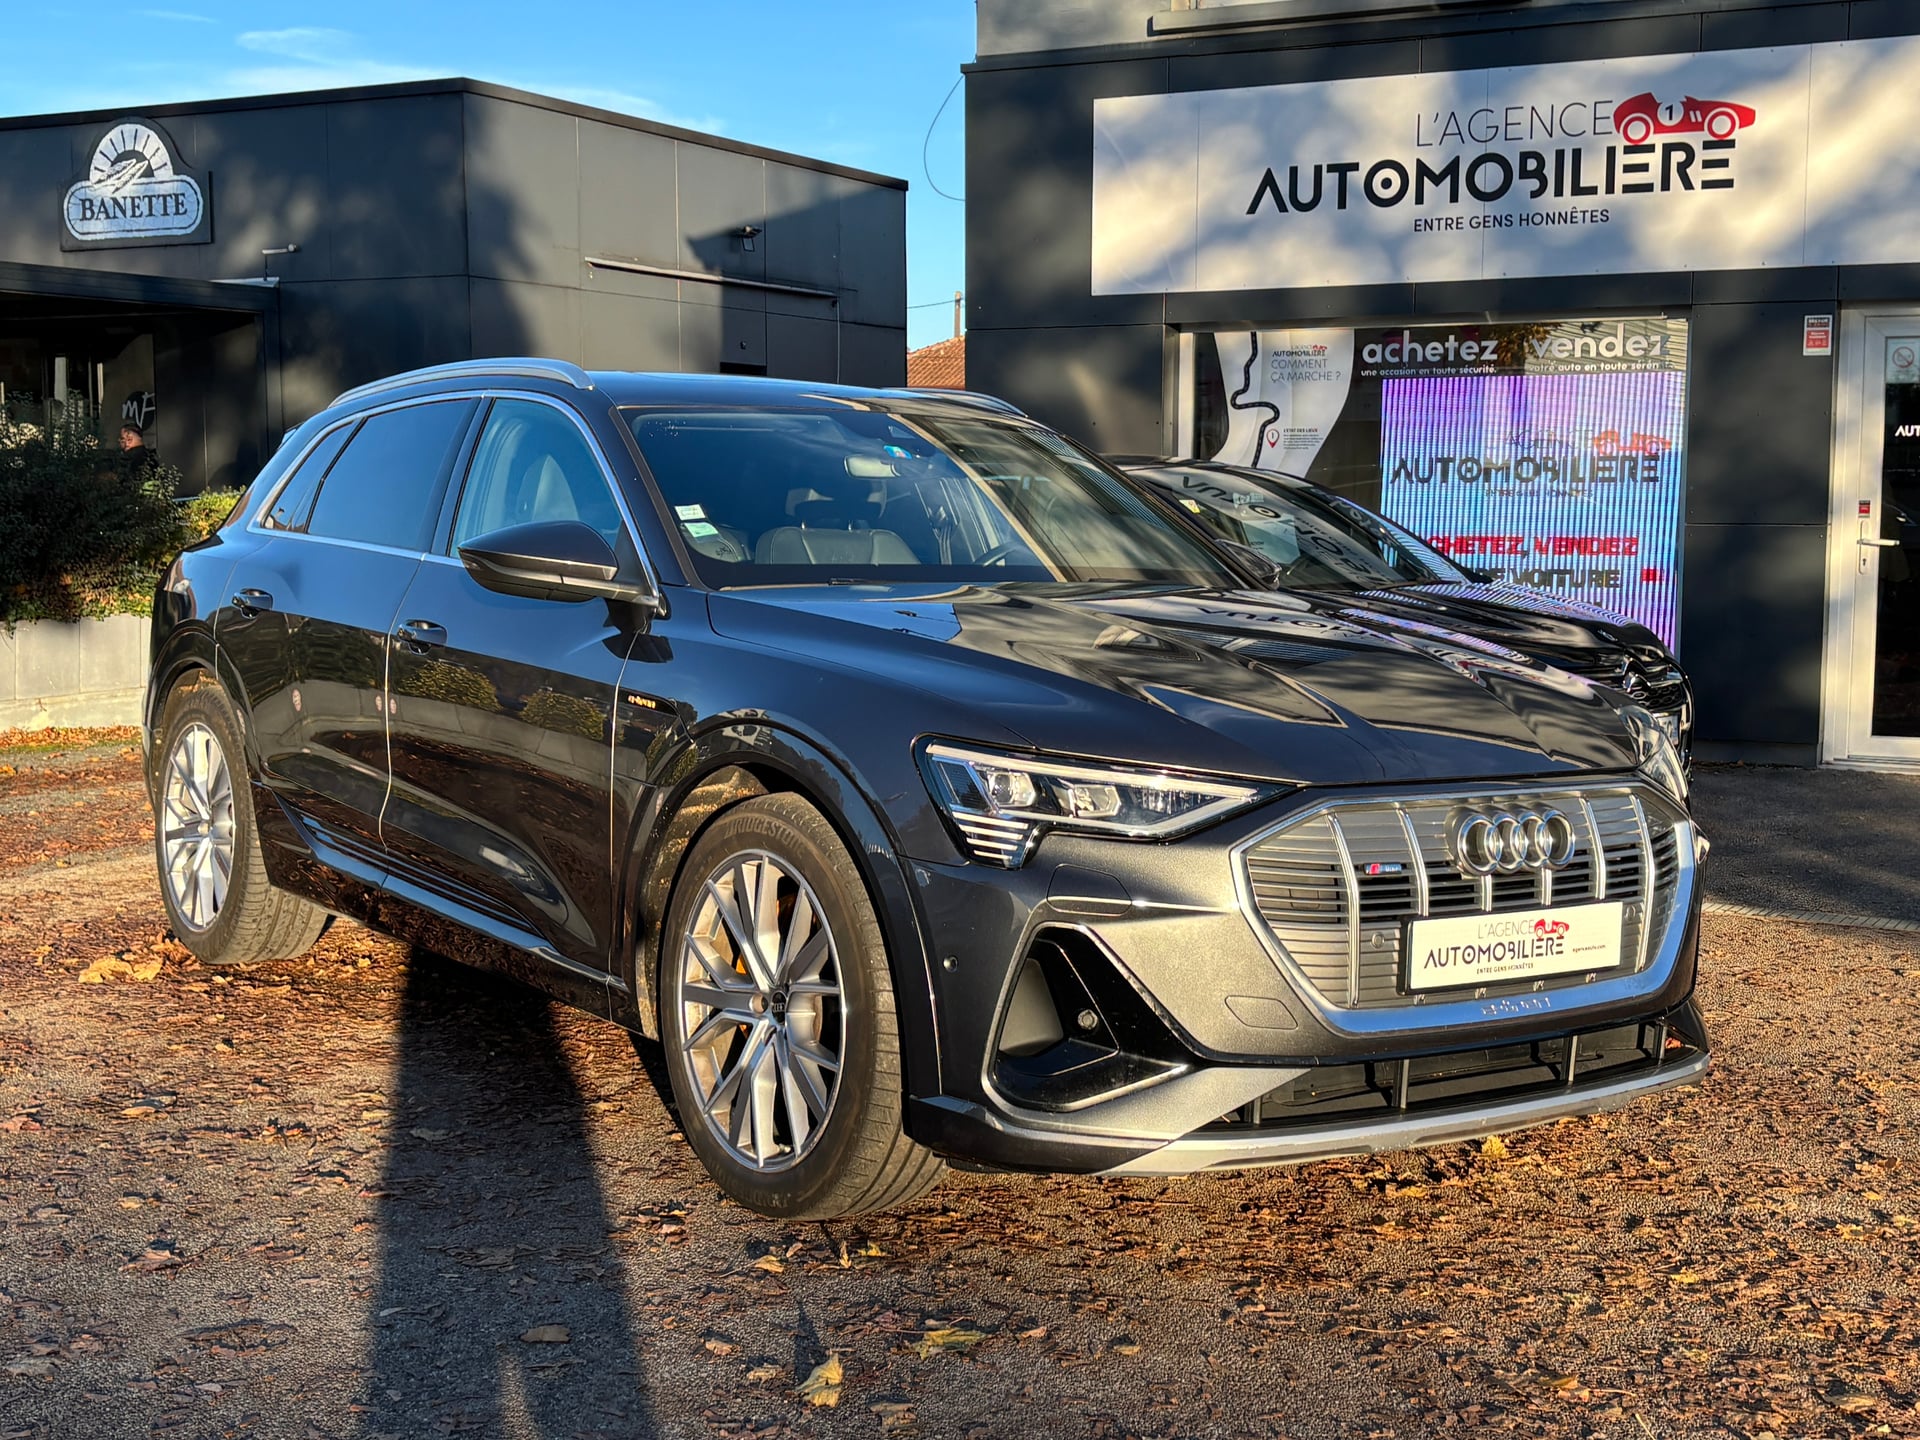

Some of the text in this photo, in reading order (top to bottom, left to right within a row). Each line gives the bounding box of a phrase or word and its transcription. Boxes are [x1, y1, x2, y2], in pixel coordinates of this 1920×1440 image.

[1416, 100, 1614, 147] L'AGENCE
[79, 192, 188, 222] BANETTE
[1413, 206, 1610, 232] ENTRE GENS HONNÊTES
[1362, 330, 1498, 364] achetez
[1531, 322, 1670, 358] vendez
[1271, 359, 1328, 370] COMMENT
[1361, 369, 1377, 377] une
[1433, 366, 1456, 375] toute
[1558, 362, 1581, 371] auto
[1600, 361, 1627, 371] toute
[1270, 371, 1285, 383] ÇA
[1286, 371, 1332, 381] MARCHE
[1427, 536, 1639, 559] CHETEZ, VENDEZ
[1478, 919, 1535, 939] L'AGENCE
